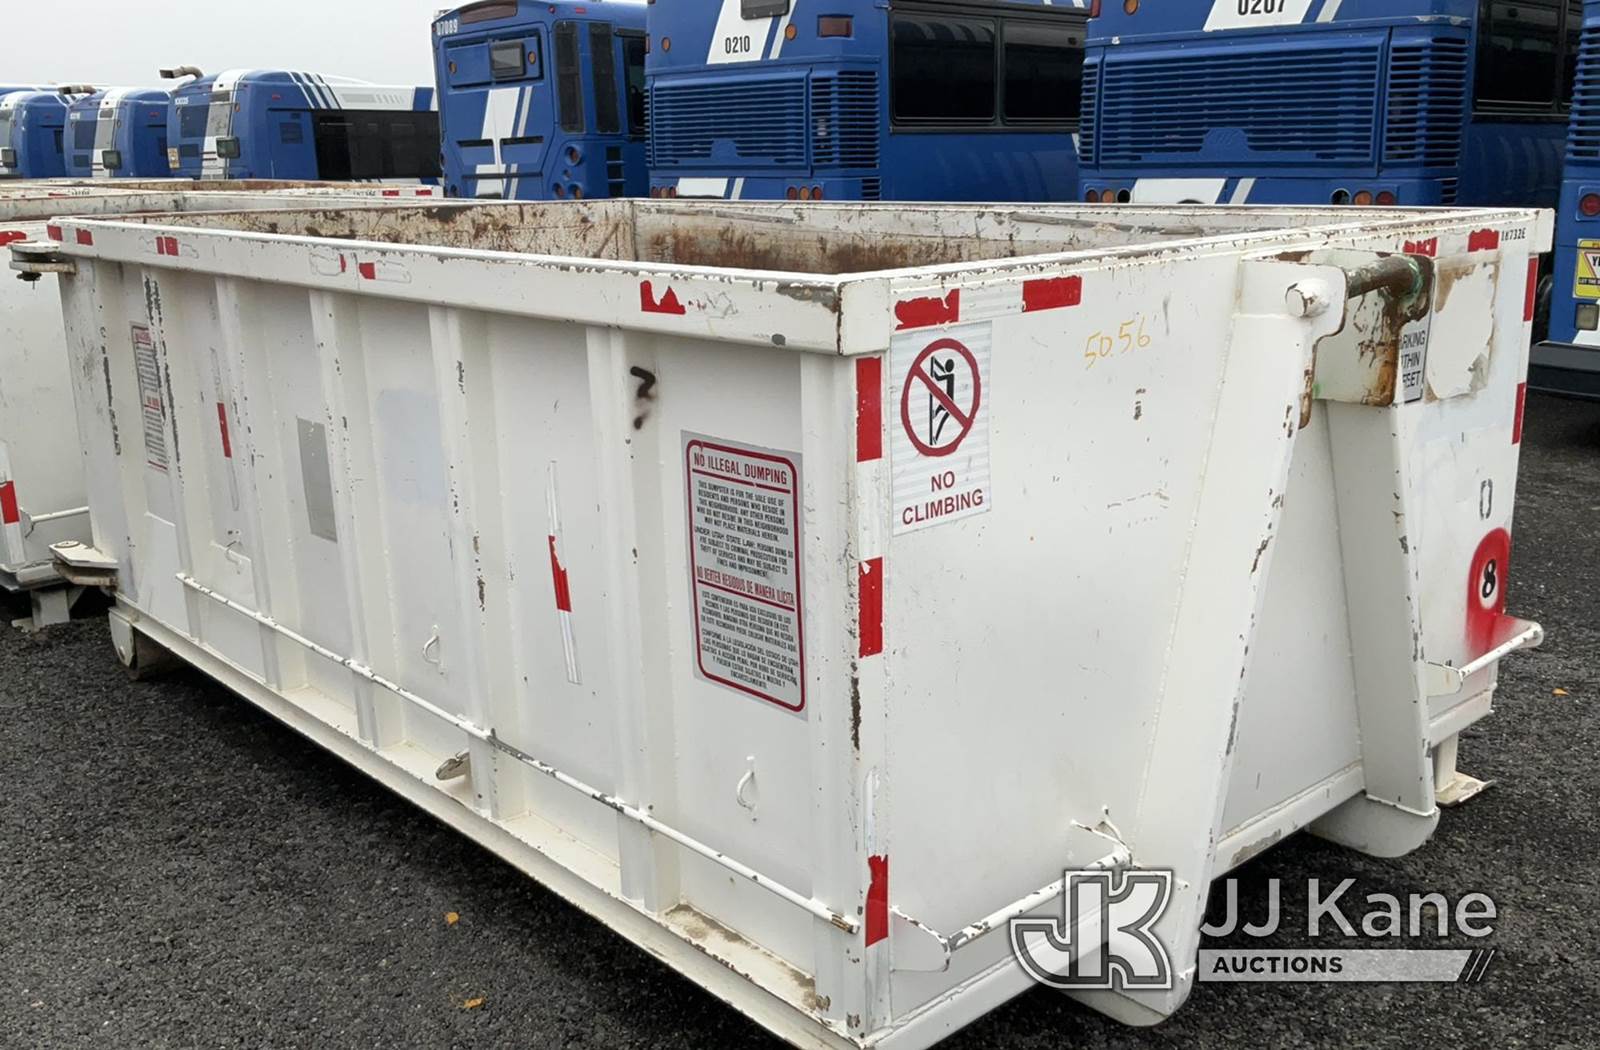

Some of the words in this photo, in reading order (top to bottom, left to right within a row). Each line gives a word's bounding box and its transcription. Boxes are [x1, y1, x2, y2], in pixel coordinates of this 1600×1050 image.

[1238, 0, 1285, 15] 0207
[725, 35, 750, 54] 0210
[694, 453, 704, 467] NO
[708, 456, 741, 475] ILLEGAL
[745, 463, 787, 485] DUMPING
[931, 471, 955, 492] NO
[902, 489, 984, 524] CLIMBING
[1482, 559, 1496, 598] 8
